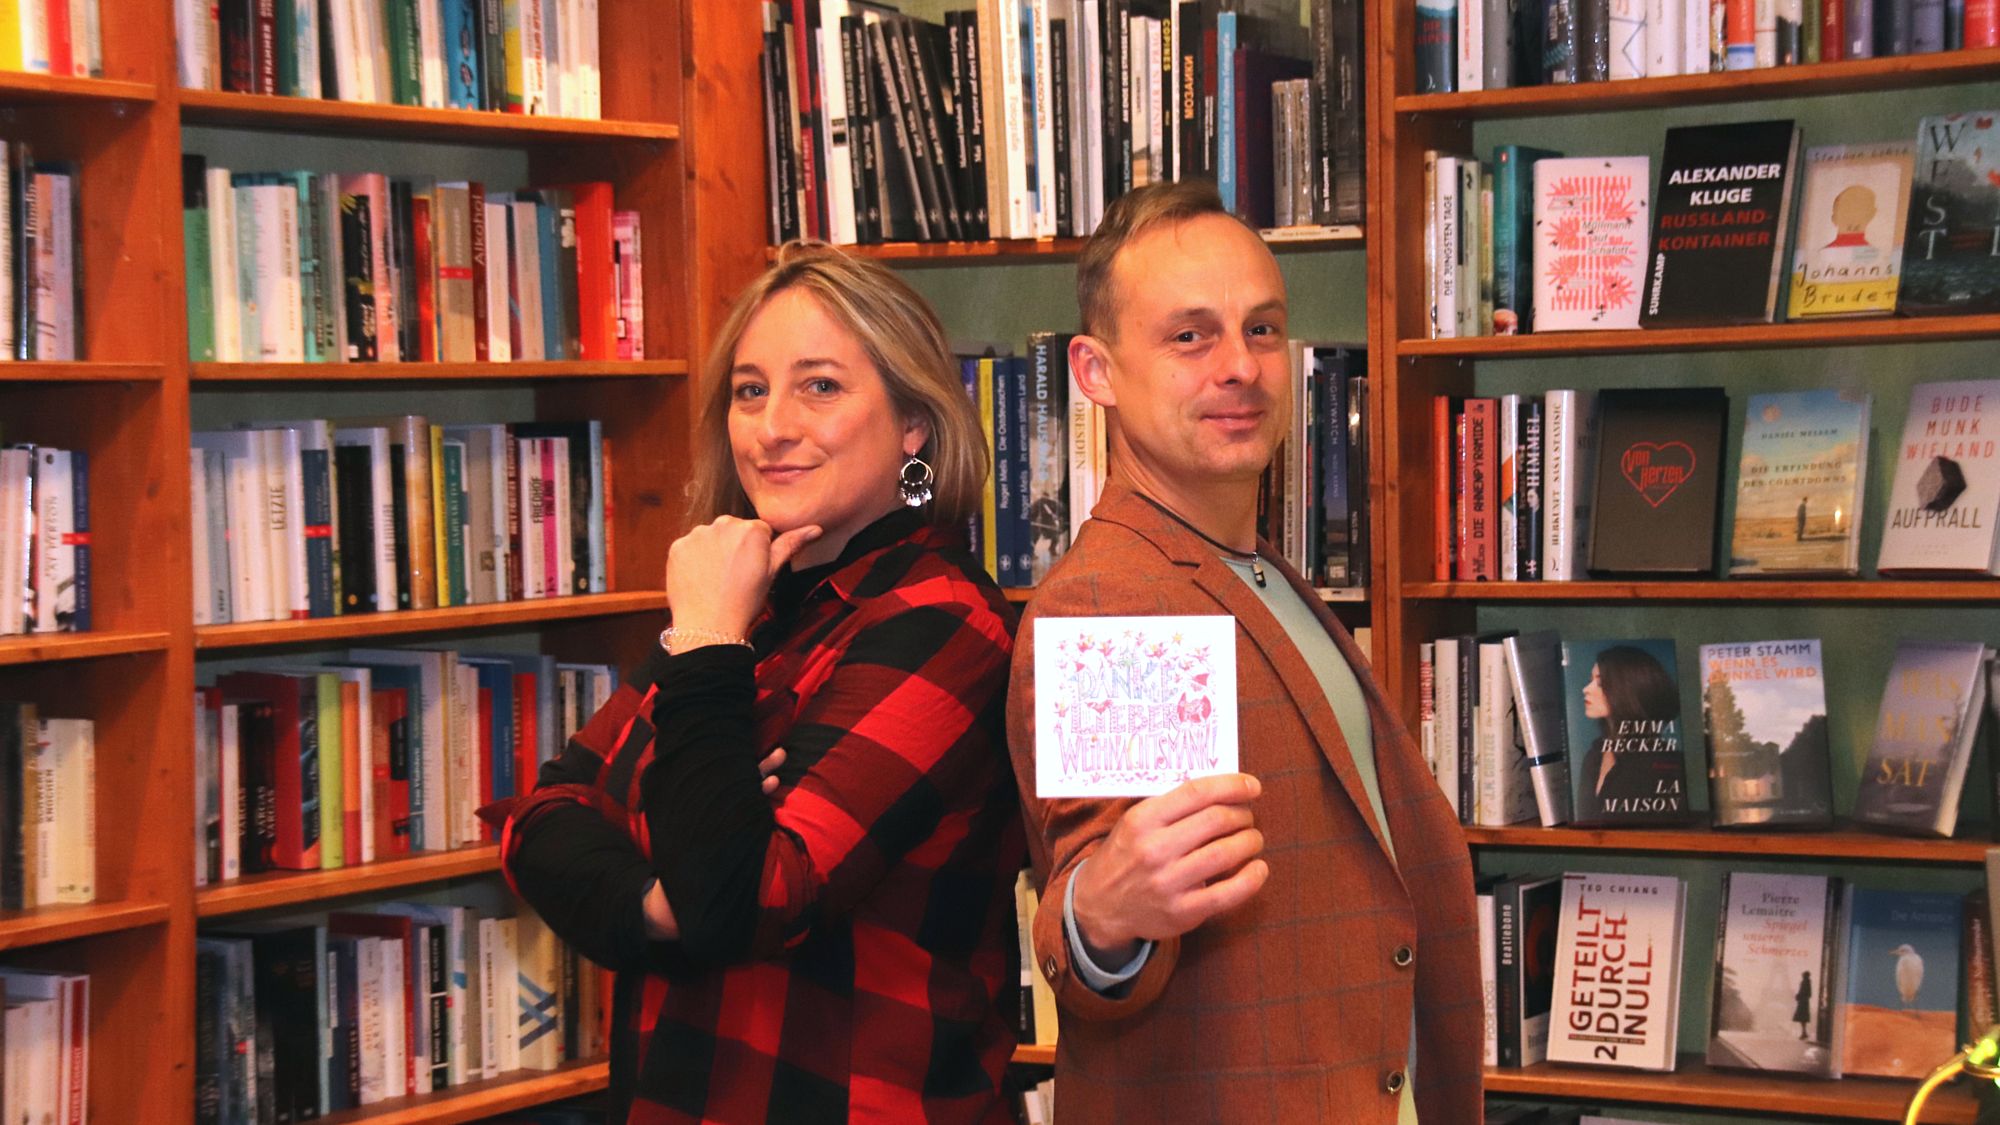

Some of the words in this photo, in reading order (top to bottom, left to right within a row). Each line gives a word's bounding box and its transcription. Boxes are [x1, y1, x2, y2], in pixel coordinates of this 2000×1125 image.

[1162, 19, 1171, 72] COPINES
[1121, 70, 1129, 87] DER
[1121, 87, 1129, 109] ENDE
[1121, 109, 1129, 123] AM
[1668, 163, 1782, 186] ALEXANDER
[1443, 194, 1453, 221] TAGE
[1689, 187, 1753, 206] KLUGE
[472, 194, 486, 265] Alkohol
[1660, 209, 1773, 230] RUSSLAND-
[1657, 231, 1771, 252] KONTAINER
[1648, 252, 1666, 317] SUHRKAMP
[1795, 263, 1893, 289] Johanns
[1442, 280, 1453, 297] DIE
[1034, 344, 1049, 400] HARALD
[1328, 372, 1339, 446] NIGHTWATCH
[1930, 395, 1985, 415] BUDE
[1074, 401, 1086, 470] DRESDEN
[1925, 419, 1982, 438] MUNK
[998, 436, 1008, 452] Die
[1526, 414, 1541, 488] HIMMEL
[1905, 440, 1996, 460] WIELAND
[998, 458, 1008, 482] Melis
[1472, 417, 1485, 513] AHNENPYRAMIDE
[1017, 469, 1028, 493] Melis
[999, 482, 1011, 509] Roger
[1019, 493, 1031, 520] Roger
[1473, 518, 1485, 539] DIE
[1890, 506, 1984, 530] AUFPRALL
[1707, 646, 1752, 660] PETER
[1757, 643, 1811, 657] STAMM
[1774, 665, 1818, 680] WIRD
[1070, 702, 1181, 735] LIEBER
[1617, 718, 1677, 736] EMMA
[1600, 737, 1679, 754] BECKER
[45, 769, 55, 823] KNOCHEN
[1654, 778, 1682, 794] LA
[256, 786, 266, 836] VARGAS
[1601, 797, 1683, 814] MAISON
[1579, 883, 1603, 893] TED
[1608, 884, 1659, 895] CHIANG
[1762, 892, 1801, 905] Pierre
[1501, 904, 1513, 966] Beatlebone
[1568, 892, 1602, 1032] GETEILT
[1595, 908, 1628, 1035] DURCH
[1623, 935, 1653, 1037] NULL
[372, 979, 381, 1051] ARTEMIS
[1593, 1045, 1618, 1061] 2
